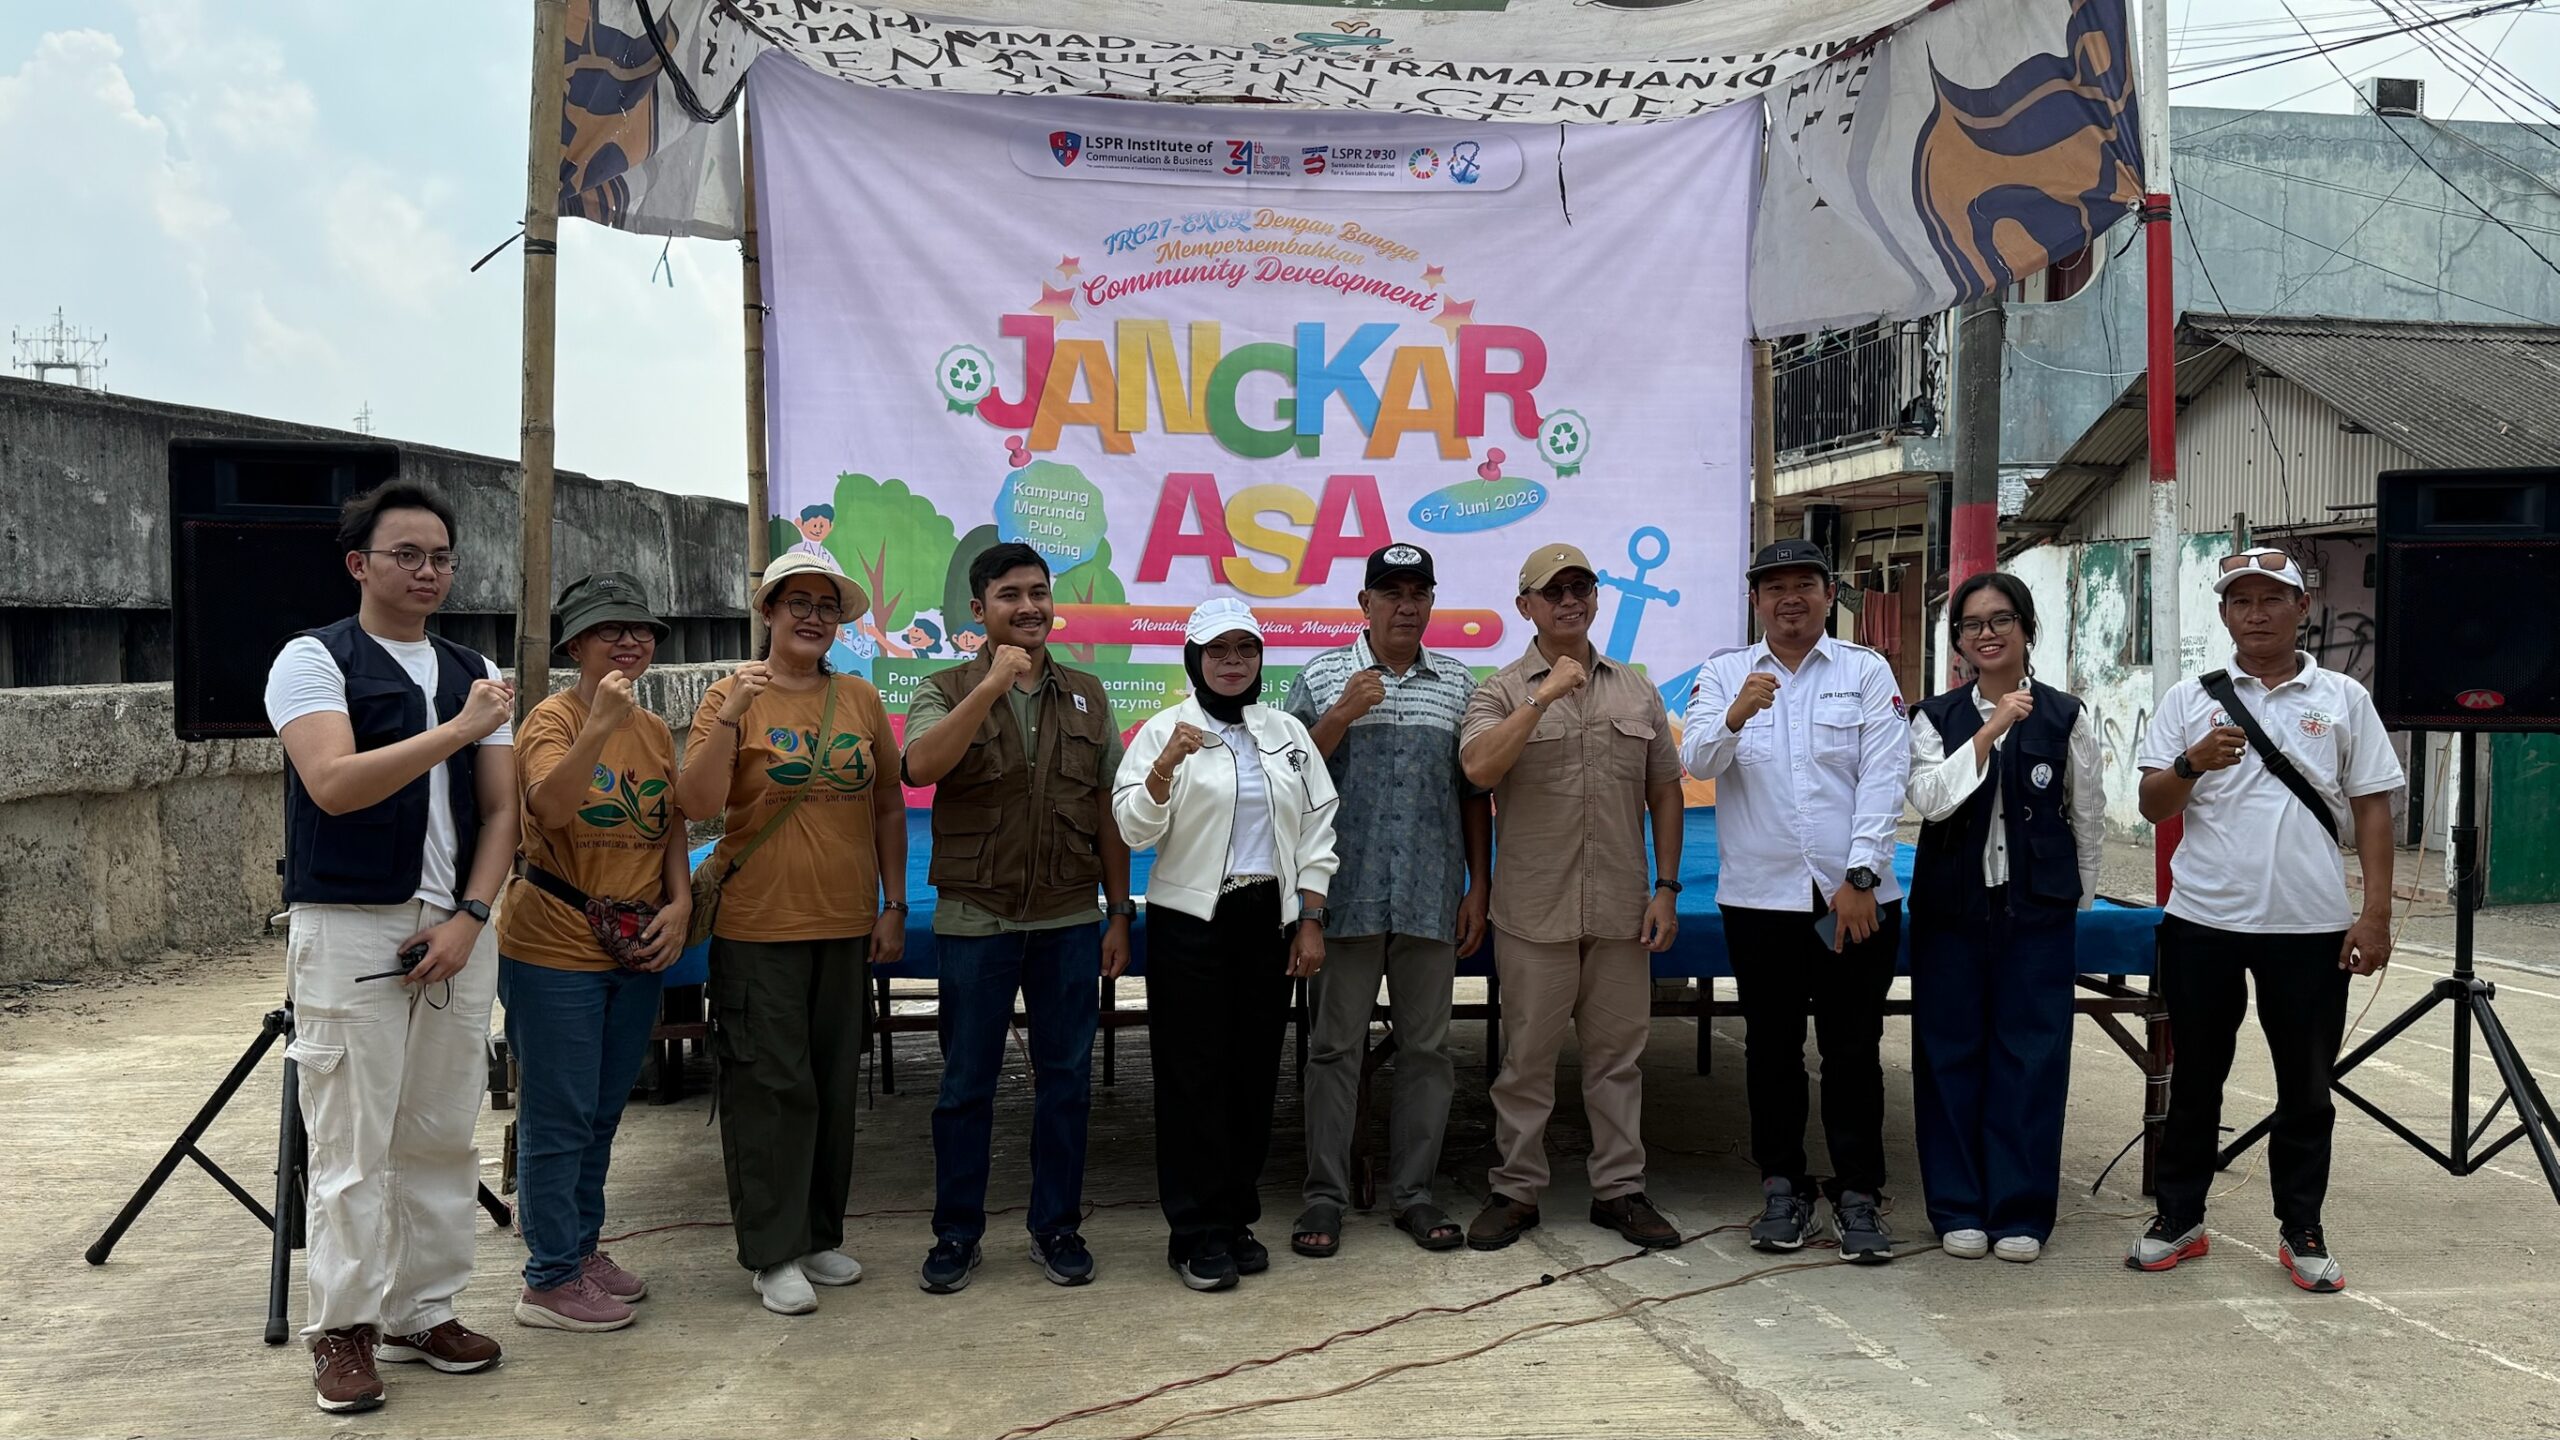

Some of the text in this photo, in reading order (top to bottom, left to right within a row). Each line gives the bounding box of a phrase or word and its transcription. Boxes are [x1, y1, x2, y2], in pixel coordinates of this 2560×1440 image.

[1387, 60, 1717, 89] RAMADHAN
[1086, 136, 1213, 153] LSPR Institute of
[1331, 148, 1362, 159] LSPR
[1086, 152, 1213, 166] Communication & Business
[1253, 155, 1290, 170] LSPR
[1255, 208, 1336, 235] Dengan
[1338, 221, 1420, 262] Bangga
[1155, 238, 1366, 266] Mempersembahkan
[1082, 256, 1437, 312] Community Development
[976, 313, 1545, 459] JANGKAR
[1013, 482, 1090, 507] Kampung
[1420, 489, 1540, 523] 6-7 Juni 2026
[1013, 500, 1086, 522] Marunda
[1028, 520, 1068, 539] Pulo,
[1136, 471, 1392, 597] ASA
[1130, 618, 1187, 632] Menaha
[1103, 678, 1166, 694] earning
[1109, 698, 1162, 711] nzyme
[842, 746, 868, 780] 4
[646, 794, 669, 829] 4
